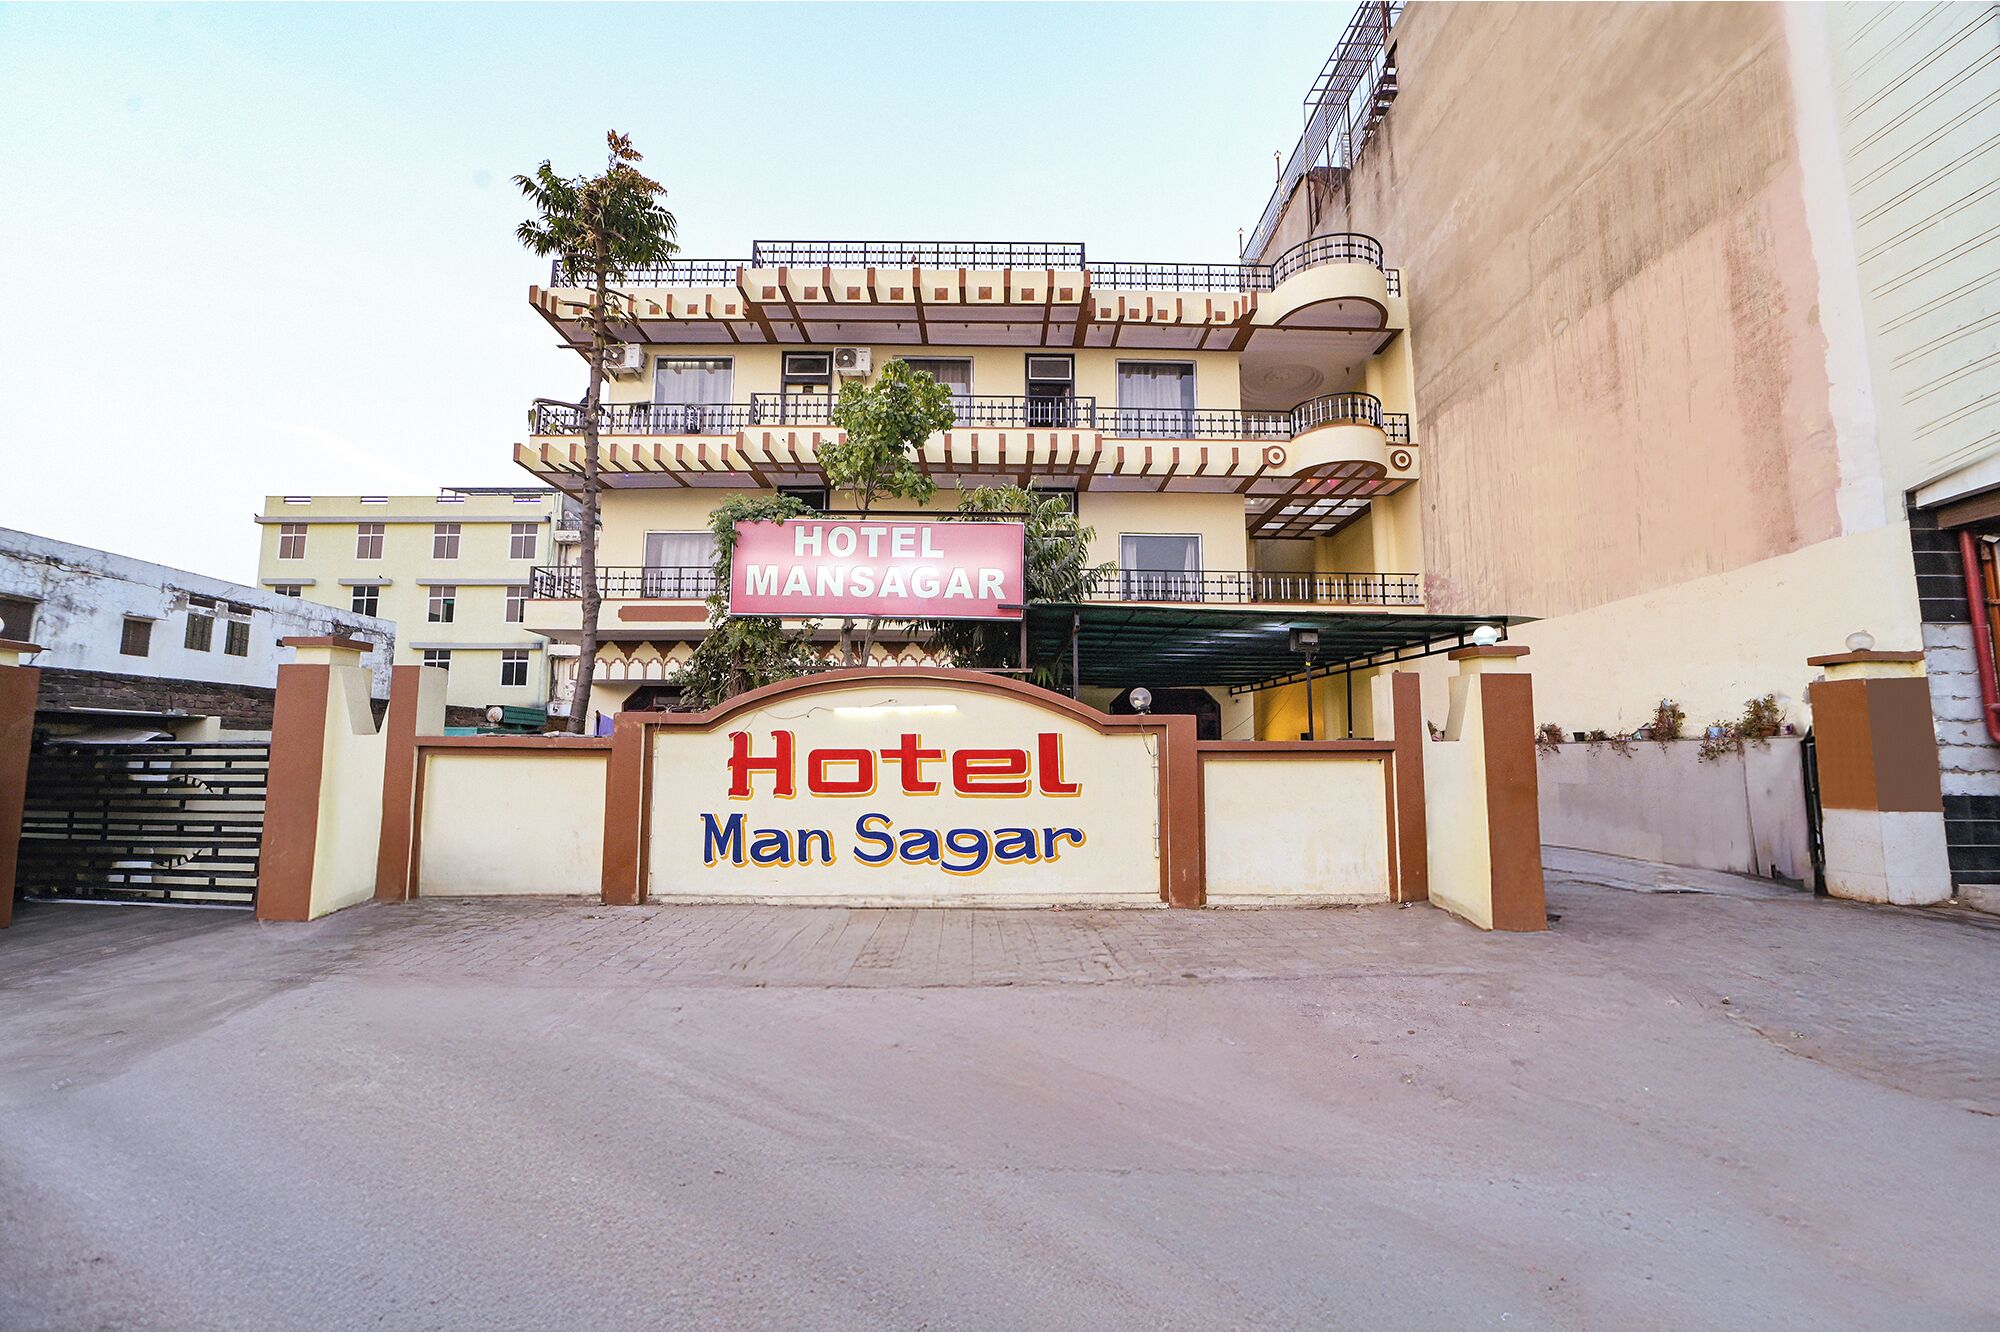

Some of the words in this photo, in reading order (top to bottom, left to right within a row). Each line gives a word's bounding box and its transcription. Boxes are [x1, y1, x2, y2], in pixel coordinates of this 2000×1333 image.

[794, 525, 944, 559] HOTEL
[745, 564, 1006, 600] MANSAGAR
[727, 729, 1083, 800] Hotel
[700, 813, 837, 868] Man
[852, 812, 1087, 877] Sagar
